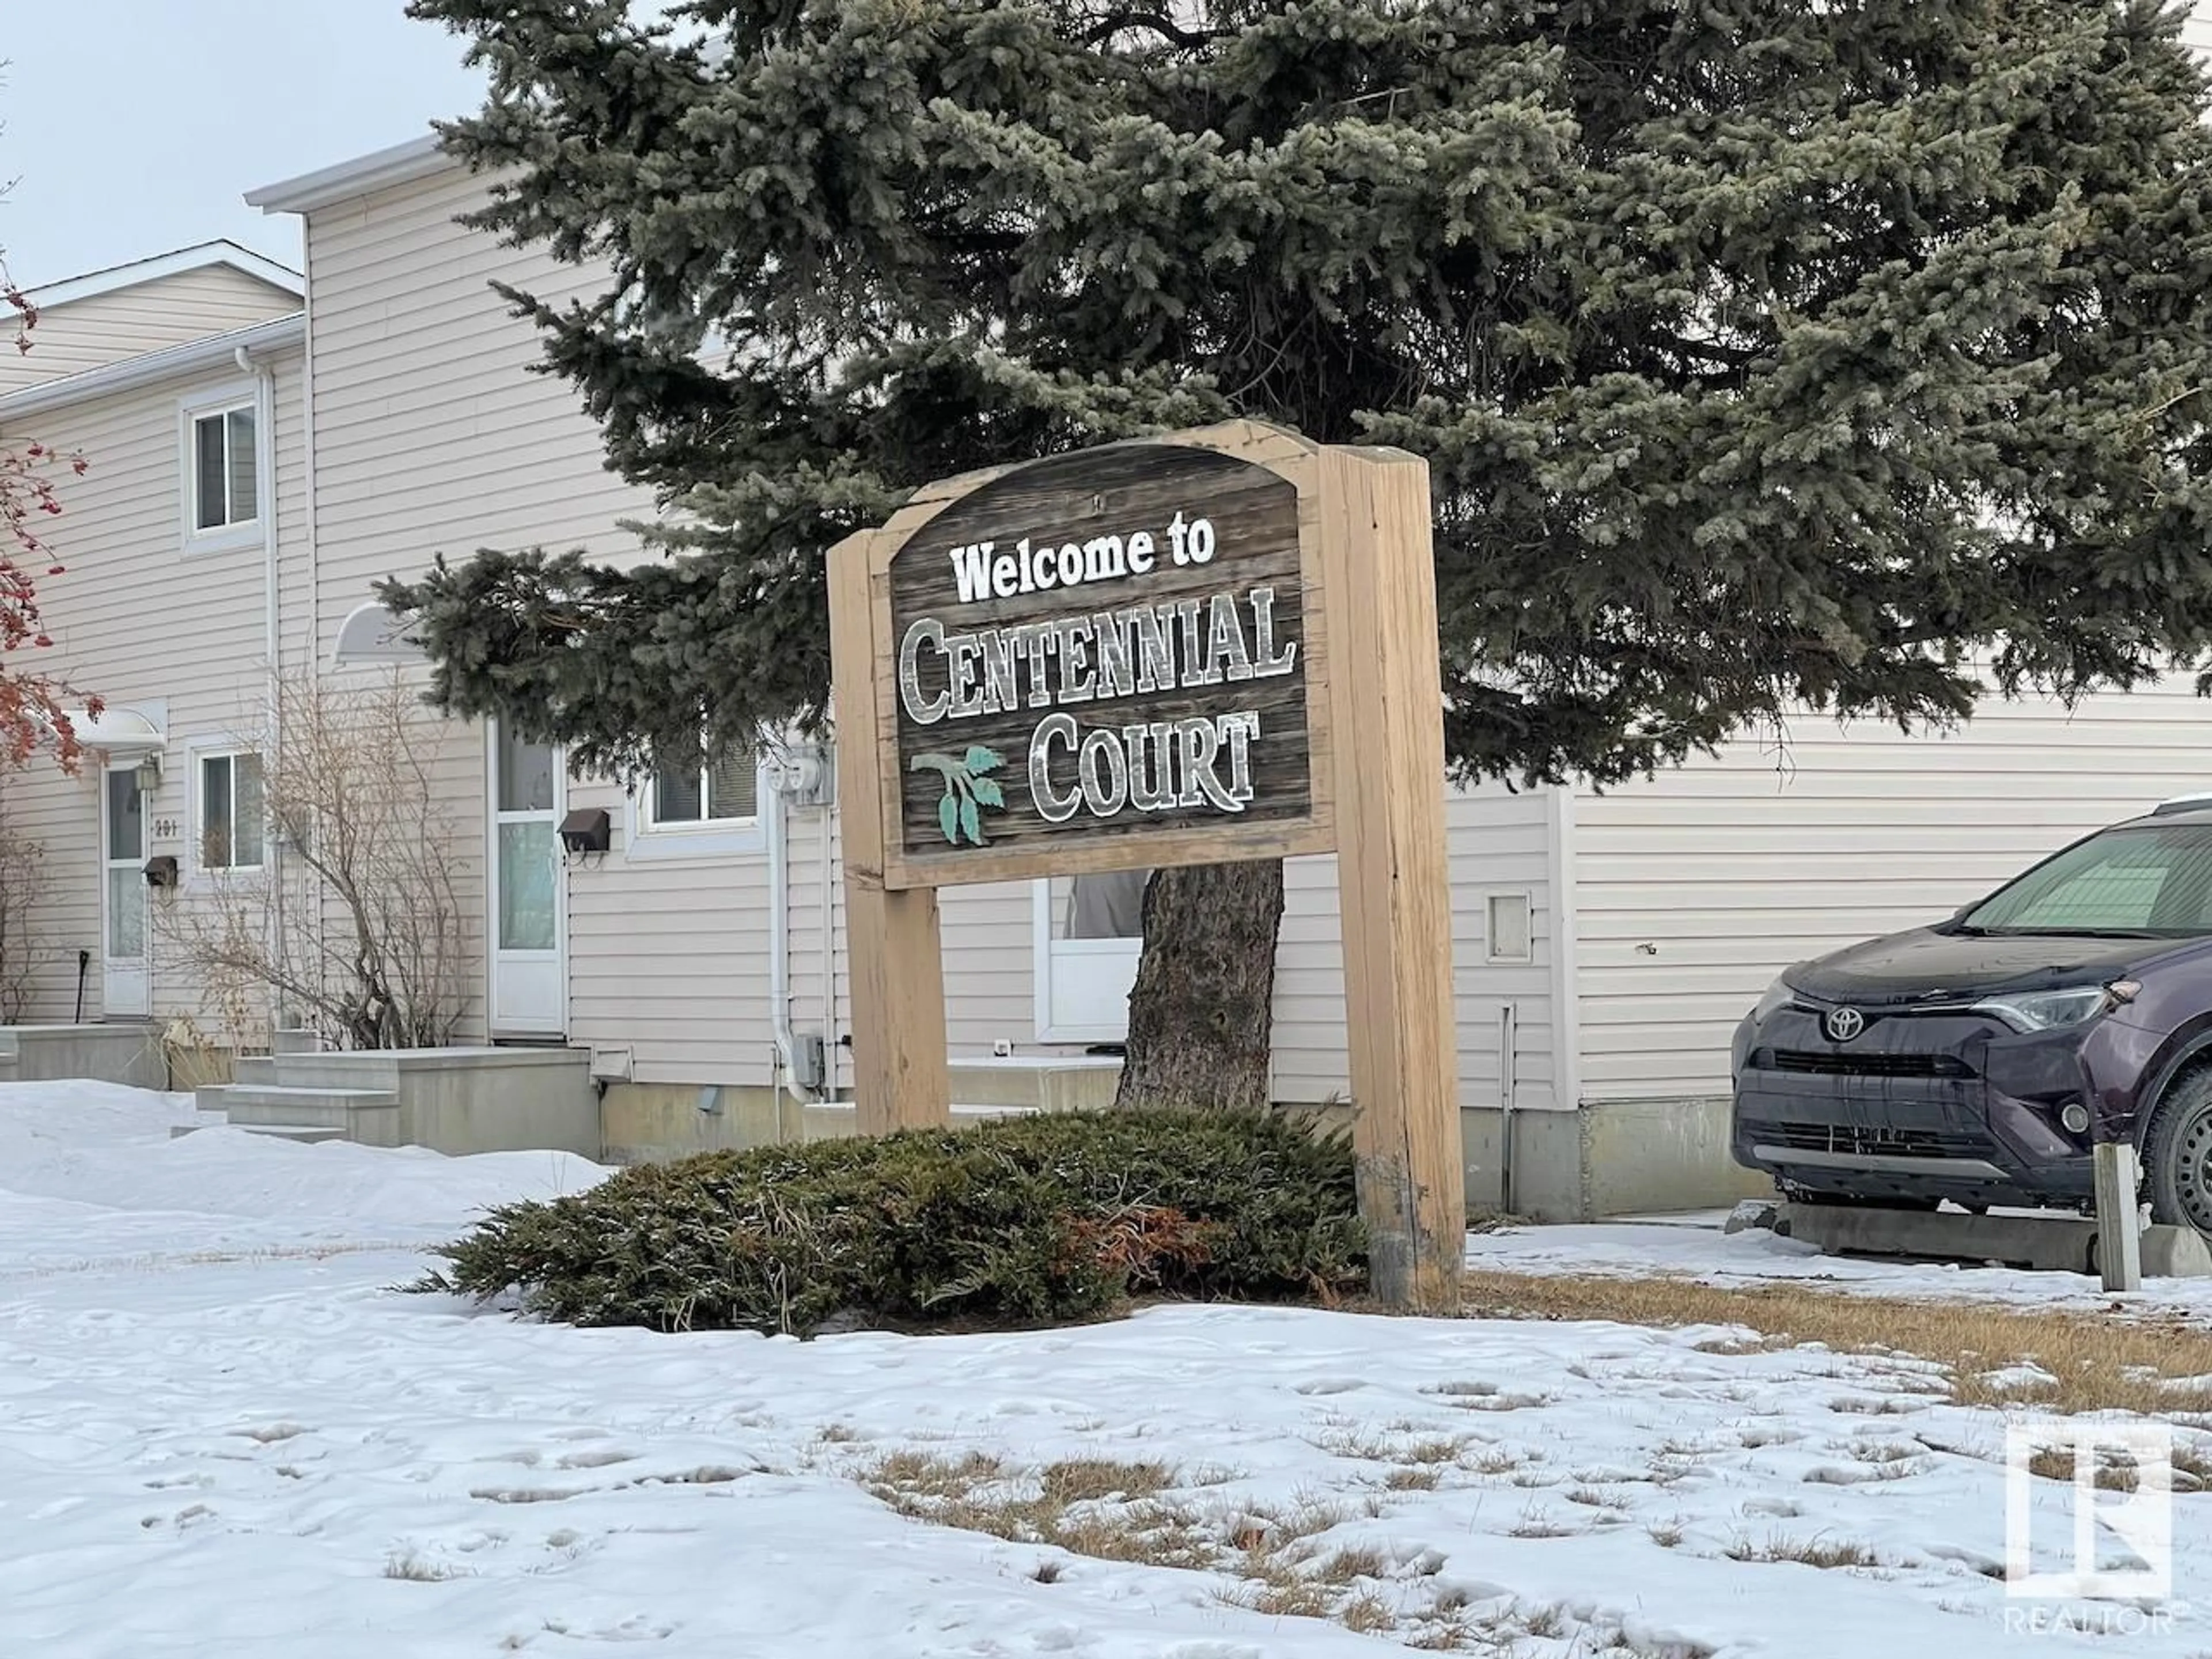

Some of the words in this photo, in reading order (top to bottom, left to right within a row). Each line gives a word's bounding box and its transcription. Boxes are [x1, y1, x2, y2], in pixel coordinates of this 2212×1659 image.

[949, 531, 1153, 603] Welcome
[1168, 510, 1215, 567] to
[898, 586, 1297, 726] CENTENNIAL
[1028, 710, 1260, 823] COURT
